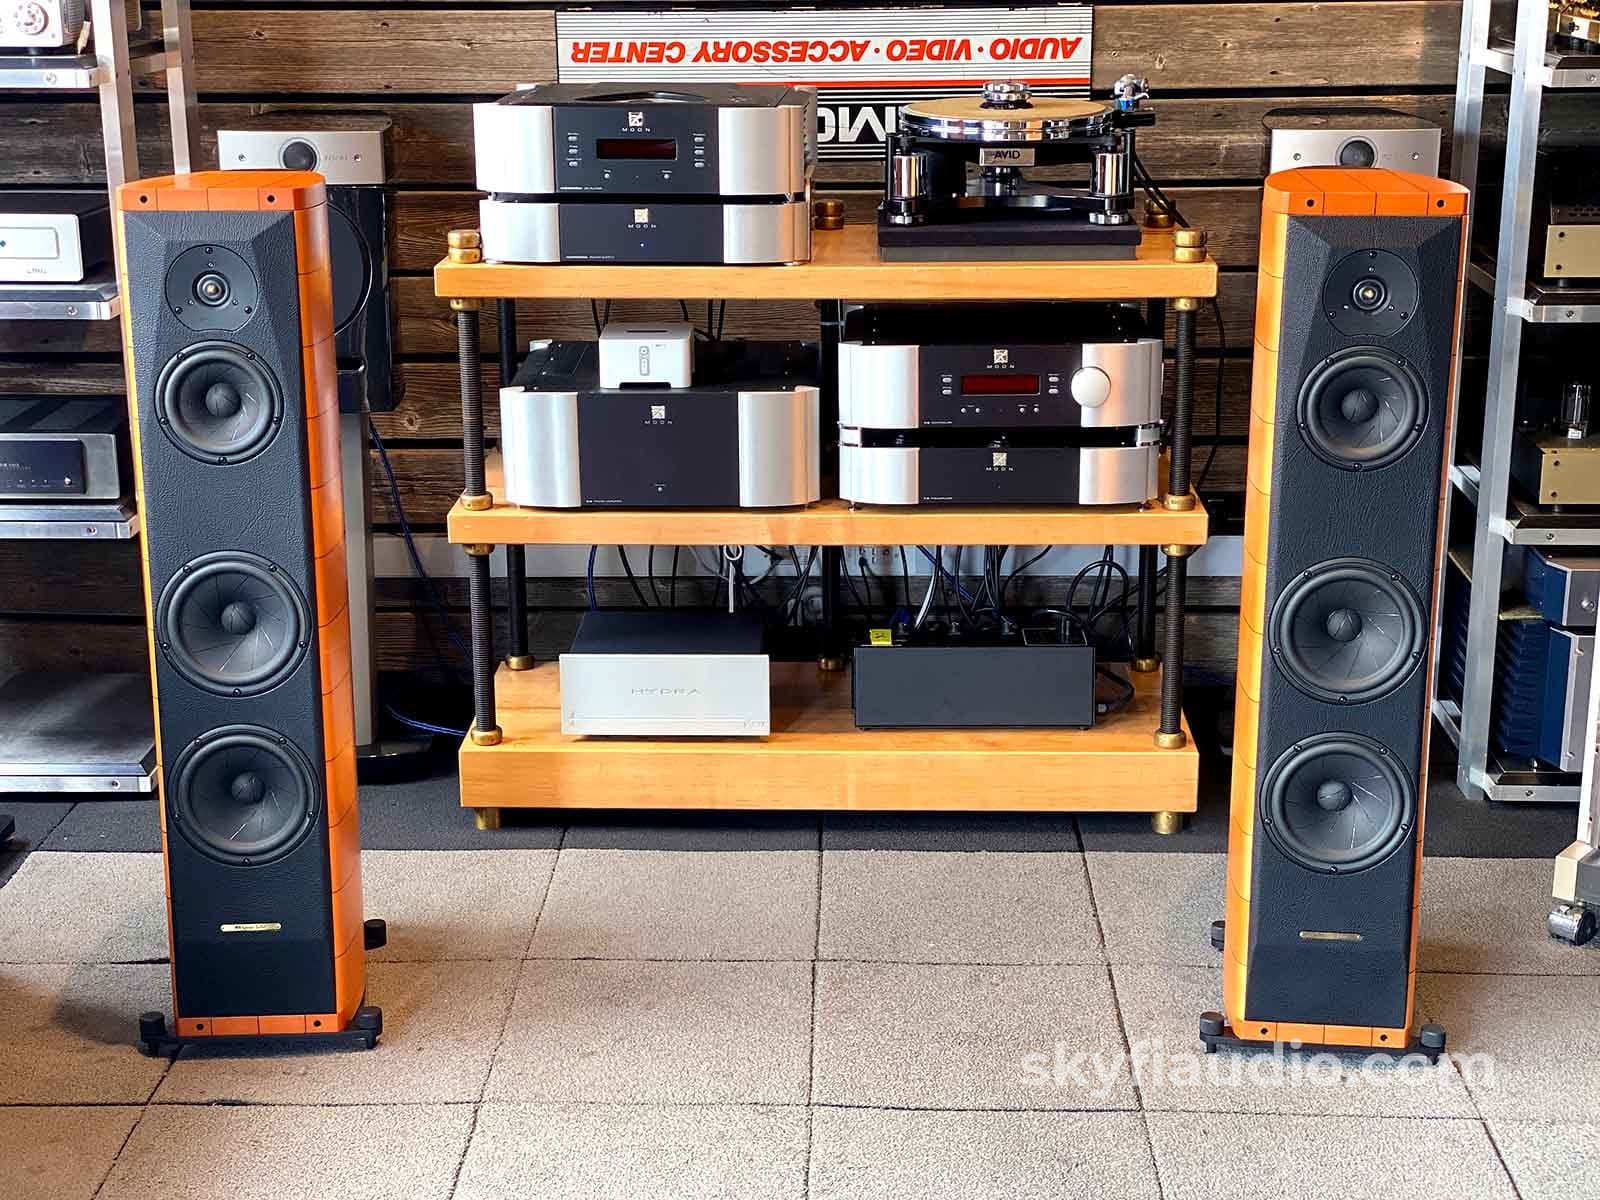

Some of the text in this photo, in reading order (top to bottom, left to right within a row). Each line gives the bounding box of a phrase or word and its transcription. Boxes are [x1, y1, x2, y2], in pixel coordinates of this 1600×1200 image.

[571, 37, 1082, 63] AUDIO VIDEO ACCESSORY CENTER
[993, 150, 1021, 159] AVID
